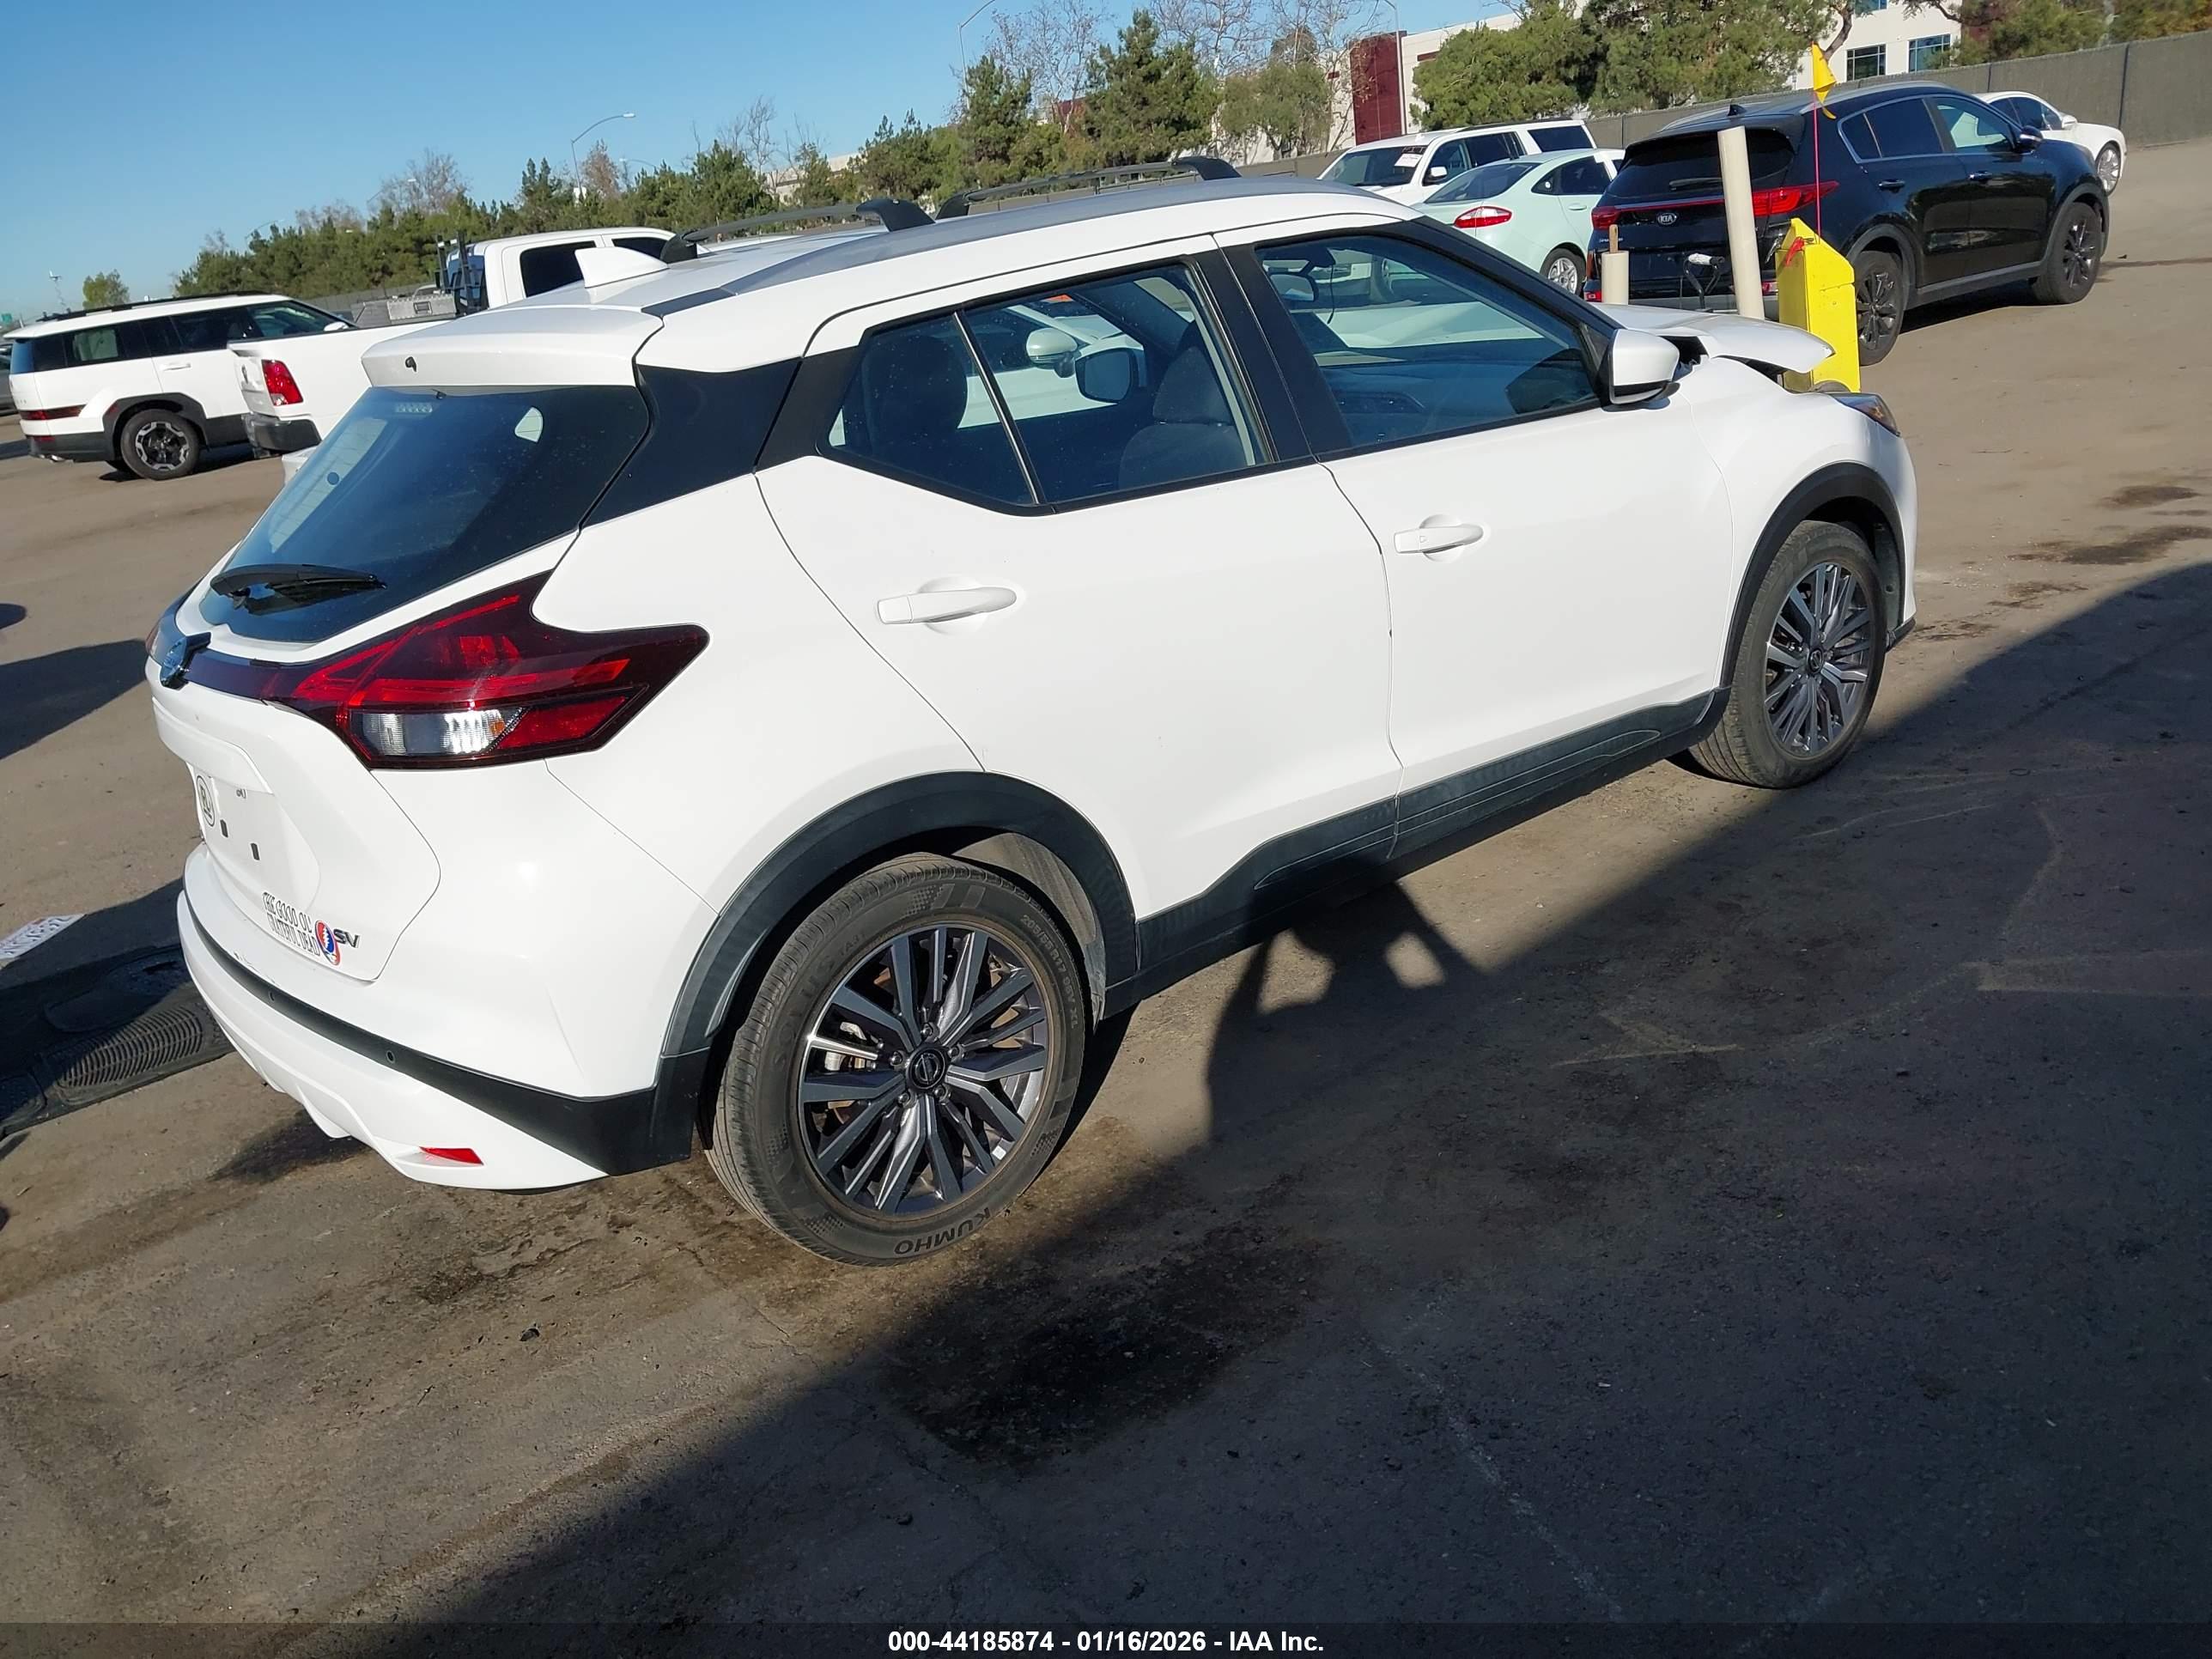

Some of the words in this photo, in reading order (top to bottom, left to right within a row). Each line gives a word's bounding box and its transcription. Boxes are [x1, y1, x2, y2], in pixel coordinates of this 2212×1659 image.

[263, 891, 276, 915] THE
[276, 900, 298, 927] GOOD
[297, 929, 320, 956] DEAD
[333, 928, 361, 948] SV
[894, 1207, 991, 1255] KUMHO
